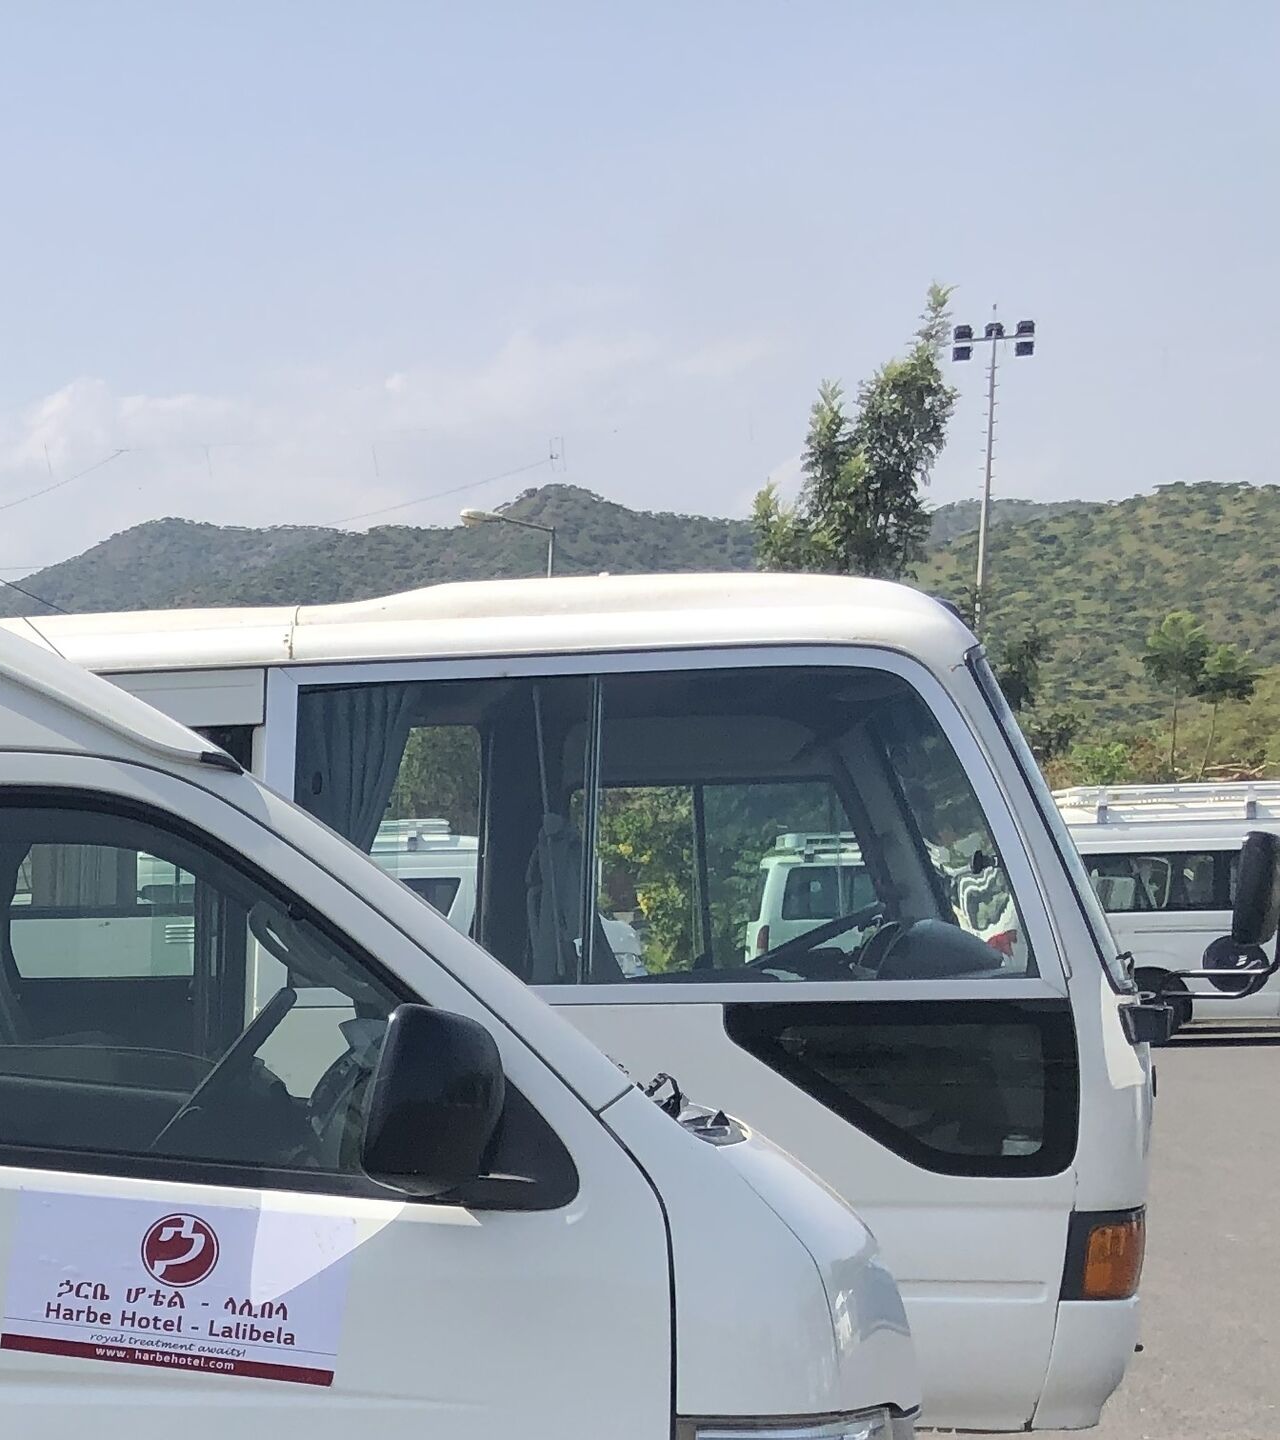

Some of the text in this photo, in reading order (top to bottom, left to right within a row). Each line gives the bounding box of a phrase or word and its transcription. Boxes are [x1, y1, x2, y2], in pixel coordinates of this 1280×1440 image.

[125, 1287, 186, 1310] ሆቴል
[44, 1301, 112, 1325] Harbe
[120, 1310, 183, 1333] Hotel
[208, 1319, 296, 1346] Lalibela
[89, 1332, 247, 1358] royal treatment awaits!
[95, 1347, 236, 1371] www. harbehotel.com
